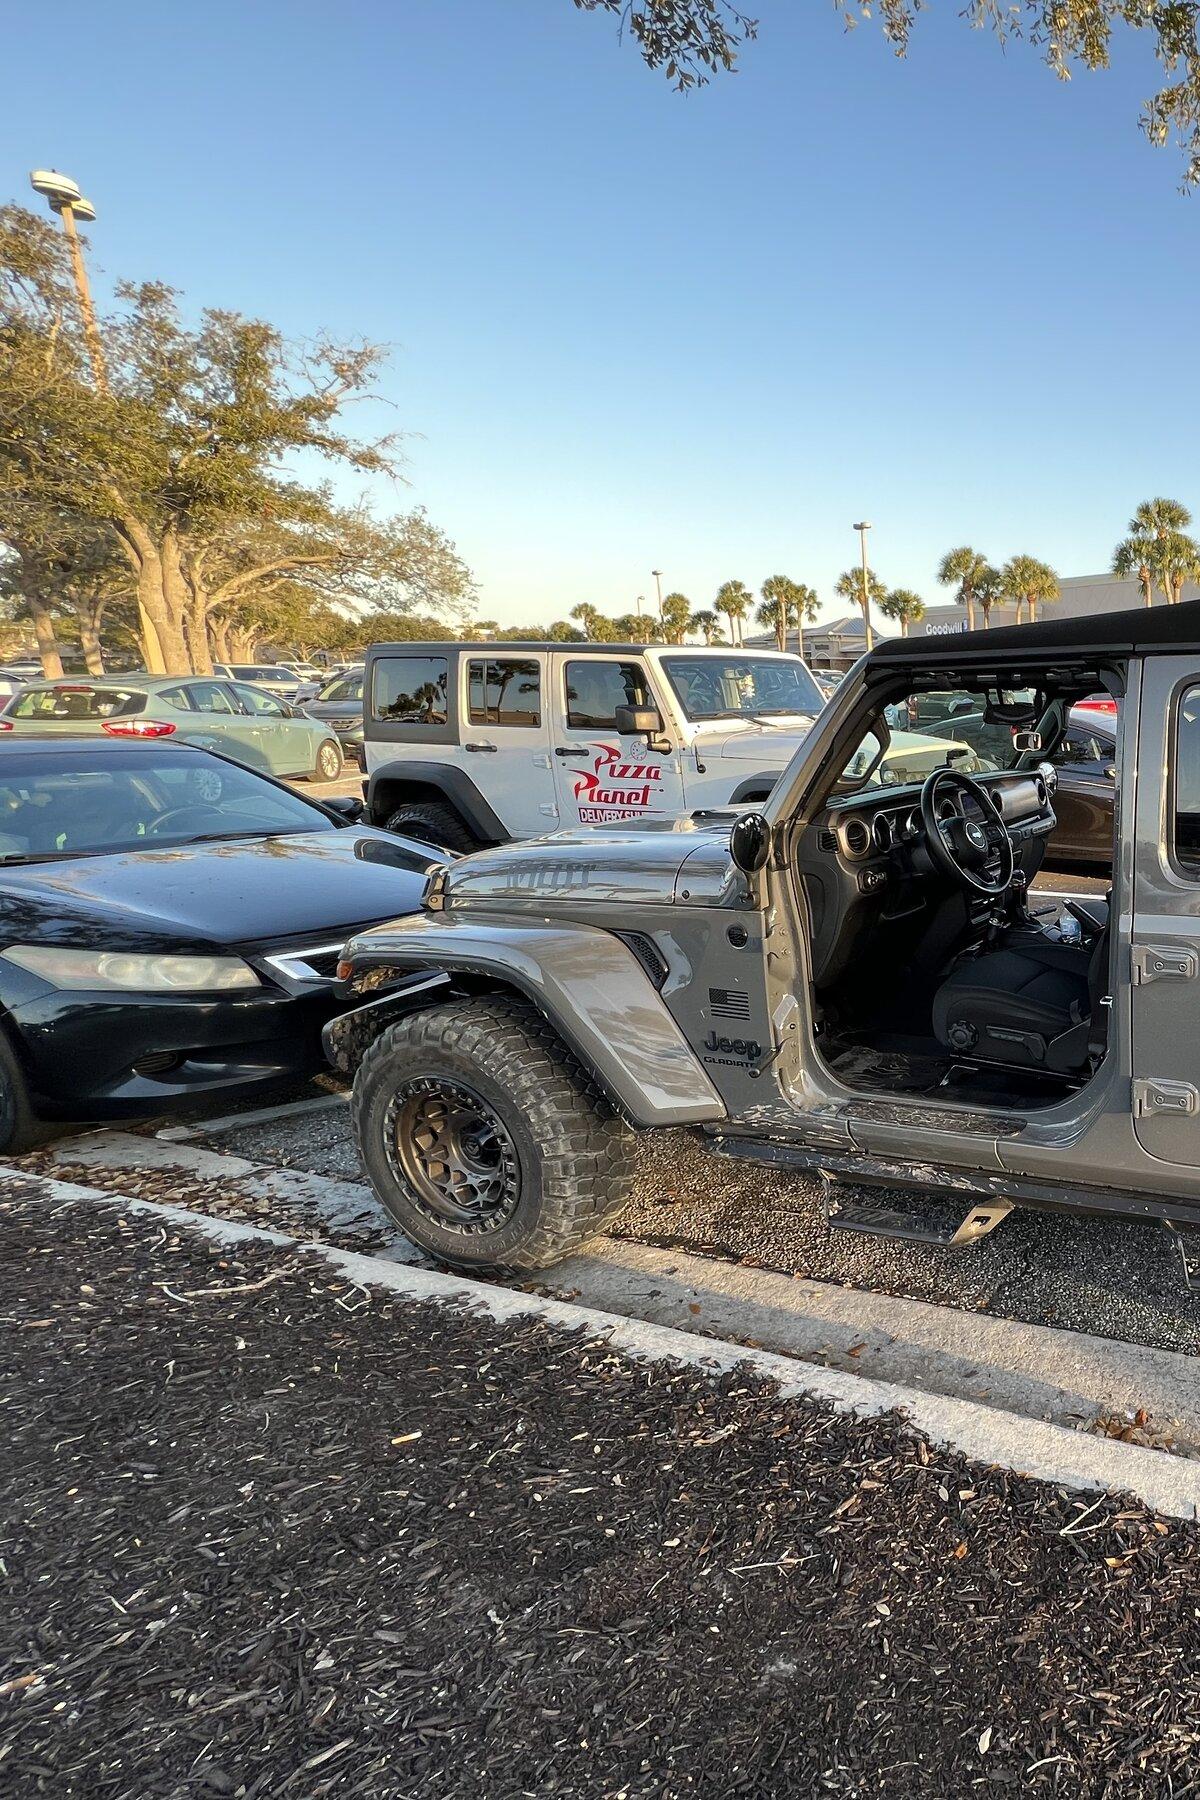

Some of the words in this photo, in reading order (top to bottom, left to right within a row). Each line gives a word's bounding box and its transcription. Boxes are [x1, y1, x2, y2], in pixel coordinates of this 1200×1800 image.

[925, 622, 963, 635] Goodwill
[589, 743, 662, 780] Pizza
[567, 769, 651, 806] Planet
[580, 808, 625, 822] DELIVERY
[704, 1030, 761, 1060] Jeep
[703, 1056, 757, 1068] GLADIAT
